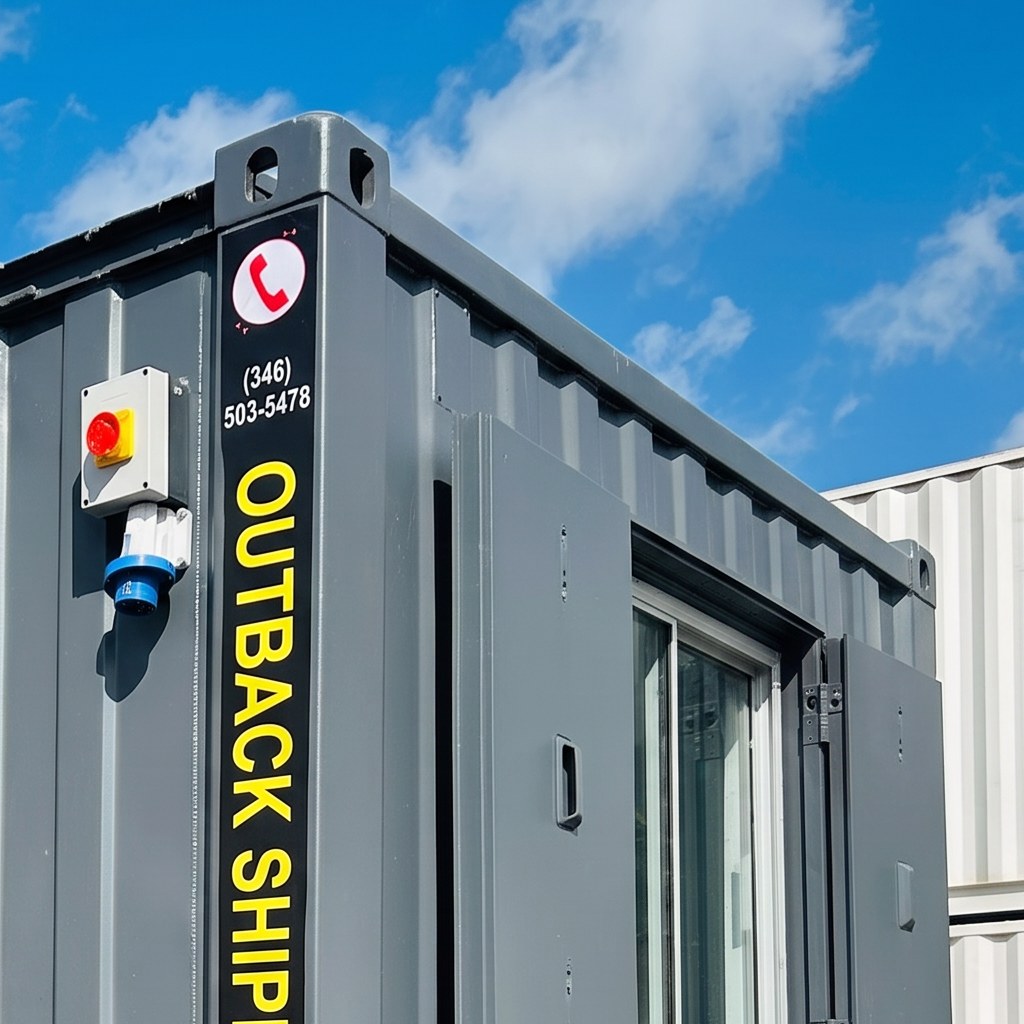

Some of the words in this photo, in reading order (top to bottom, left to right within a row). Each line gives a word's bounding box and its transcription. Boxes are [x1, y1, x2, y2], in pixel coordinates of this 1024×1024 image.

[243, 356, 291, 396] (346)
[224, 384, 311, 429] 503-5478
[232, 461, 296, 827] OUTBACK
